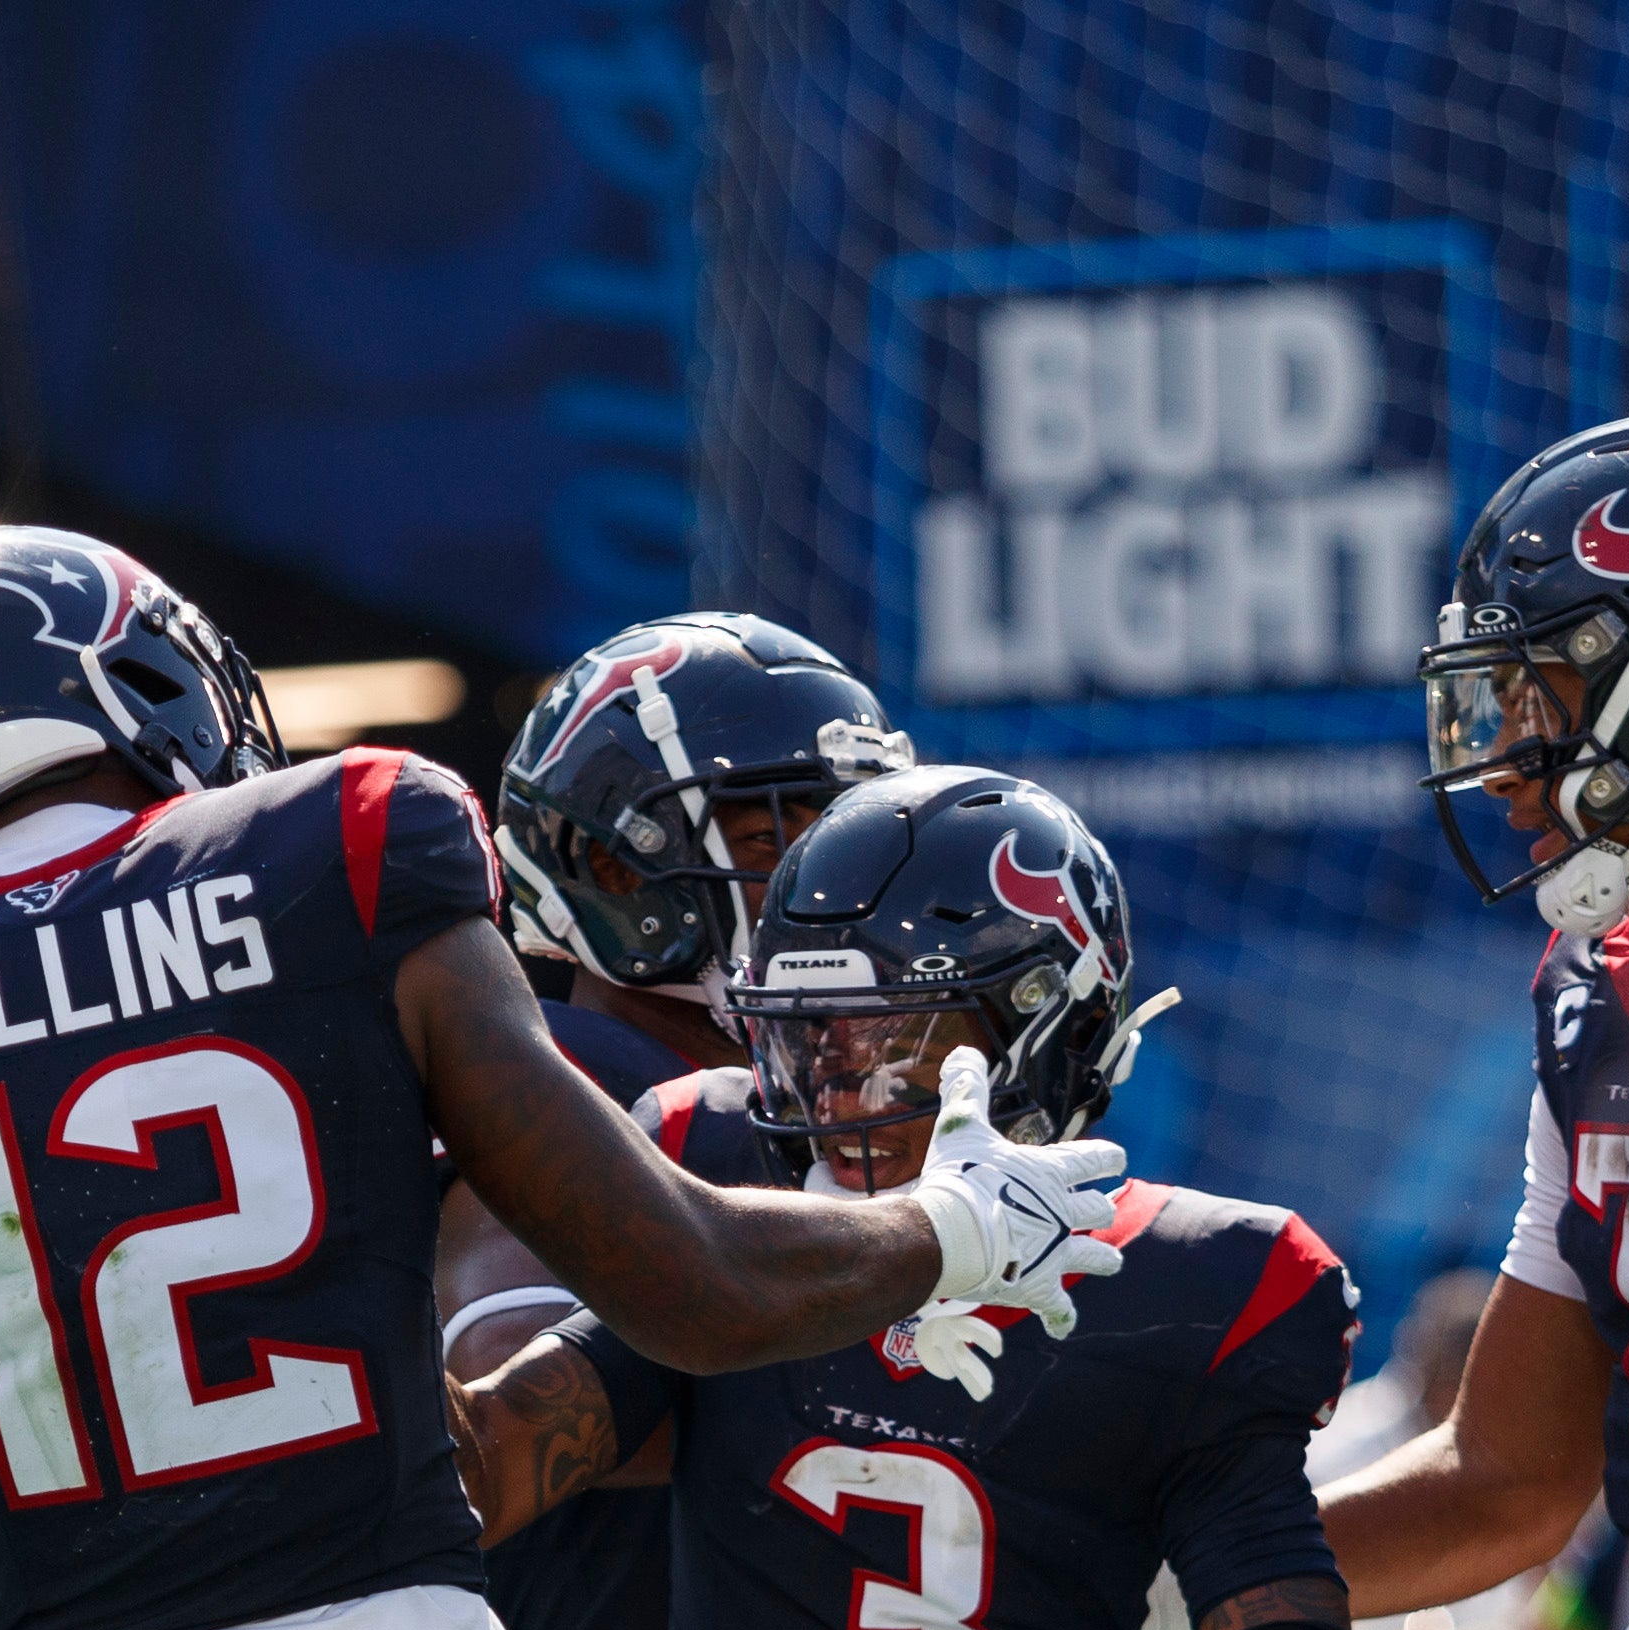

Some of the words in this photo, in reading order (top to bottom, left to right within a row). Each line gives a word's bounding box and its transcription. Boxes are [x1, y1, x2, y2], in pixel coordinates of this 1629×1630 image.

[978, 284, 1378, 488] BUD
[916, 474, 1450, 706] LIGHT
[1468, 622, 1517, 636] OAKLEY
[778, 958, 849, 971] TEXANS
[902, 970, 967, 983] OAKLEY
